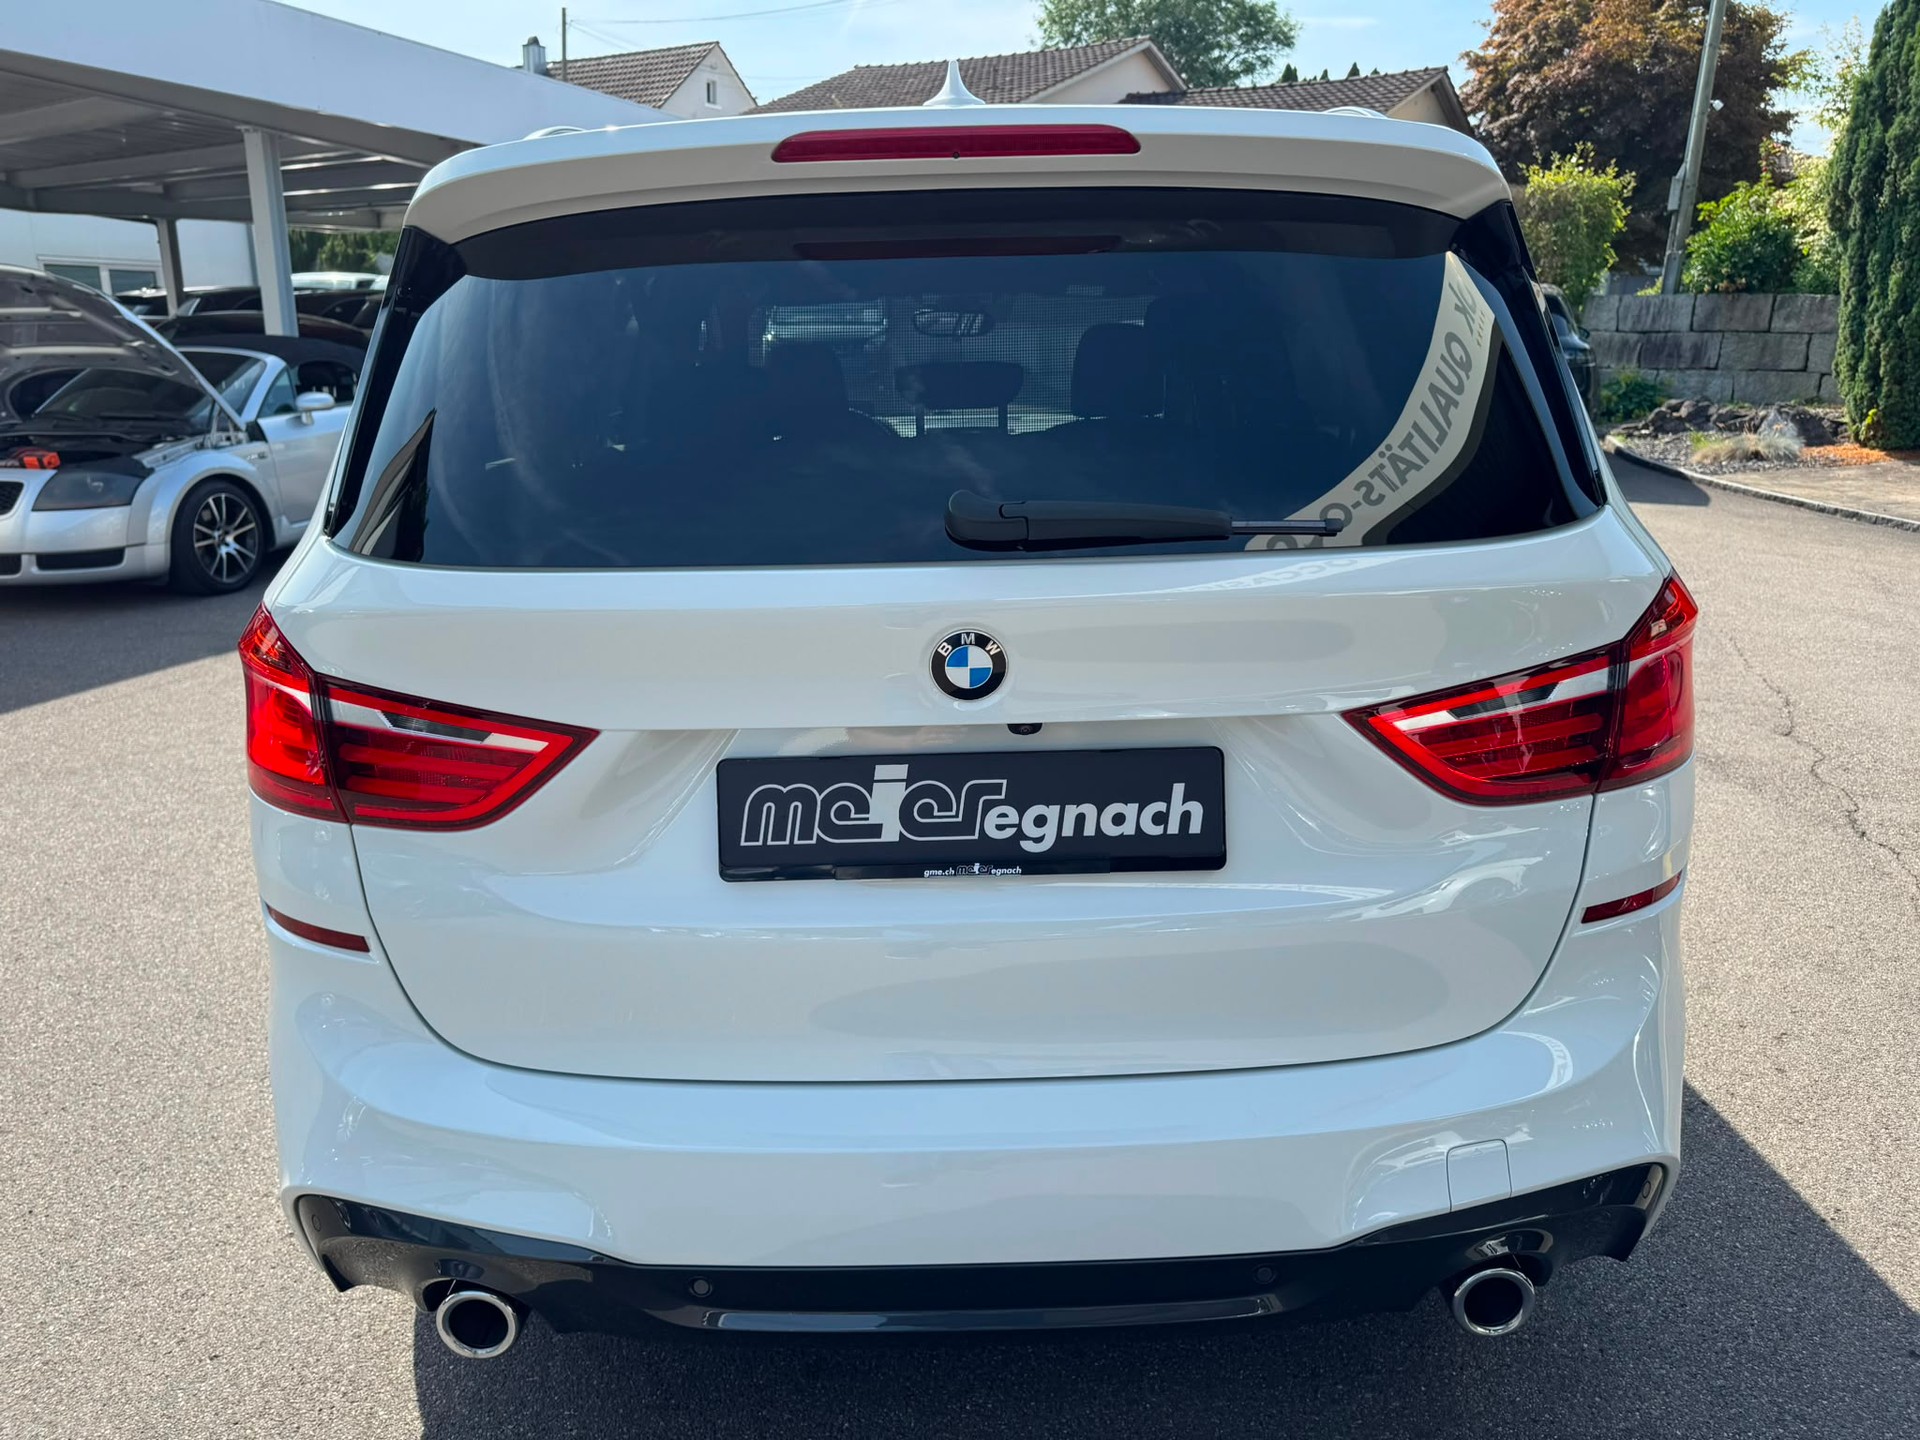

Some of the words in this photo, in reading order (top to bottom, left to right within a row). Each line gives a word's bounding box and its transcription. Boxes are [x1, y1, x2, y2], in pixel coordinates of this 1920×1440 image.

[937, 632, 1001, 656] BMW
[984, 783, 1204, 853] egnach
[923, 867, 955, 878] gme.ch
[991, 865, 1022, 877] egnach
